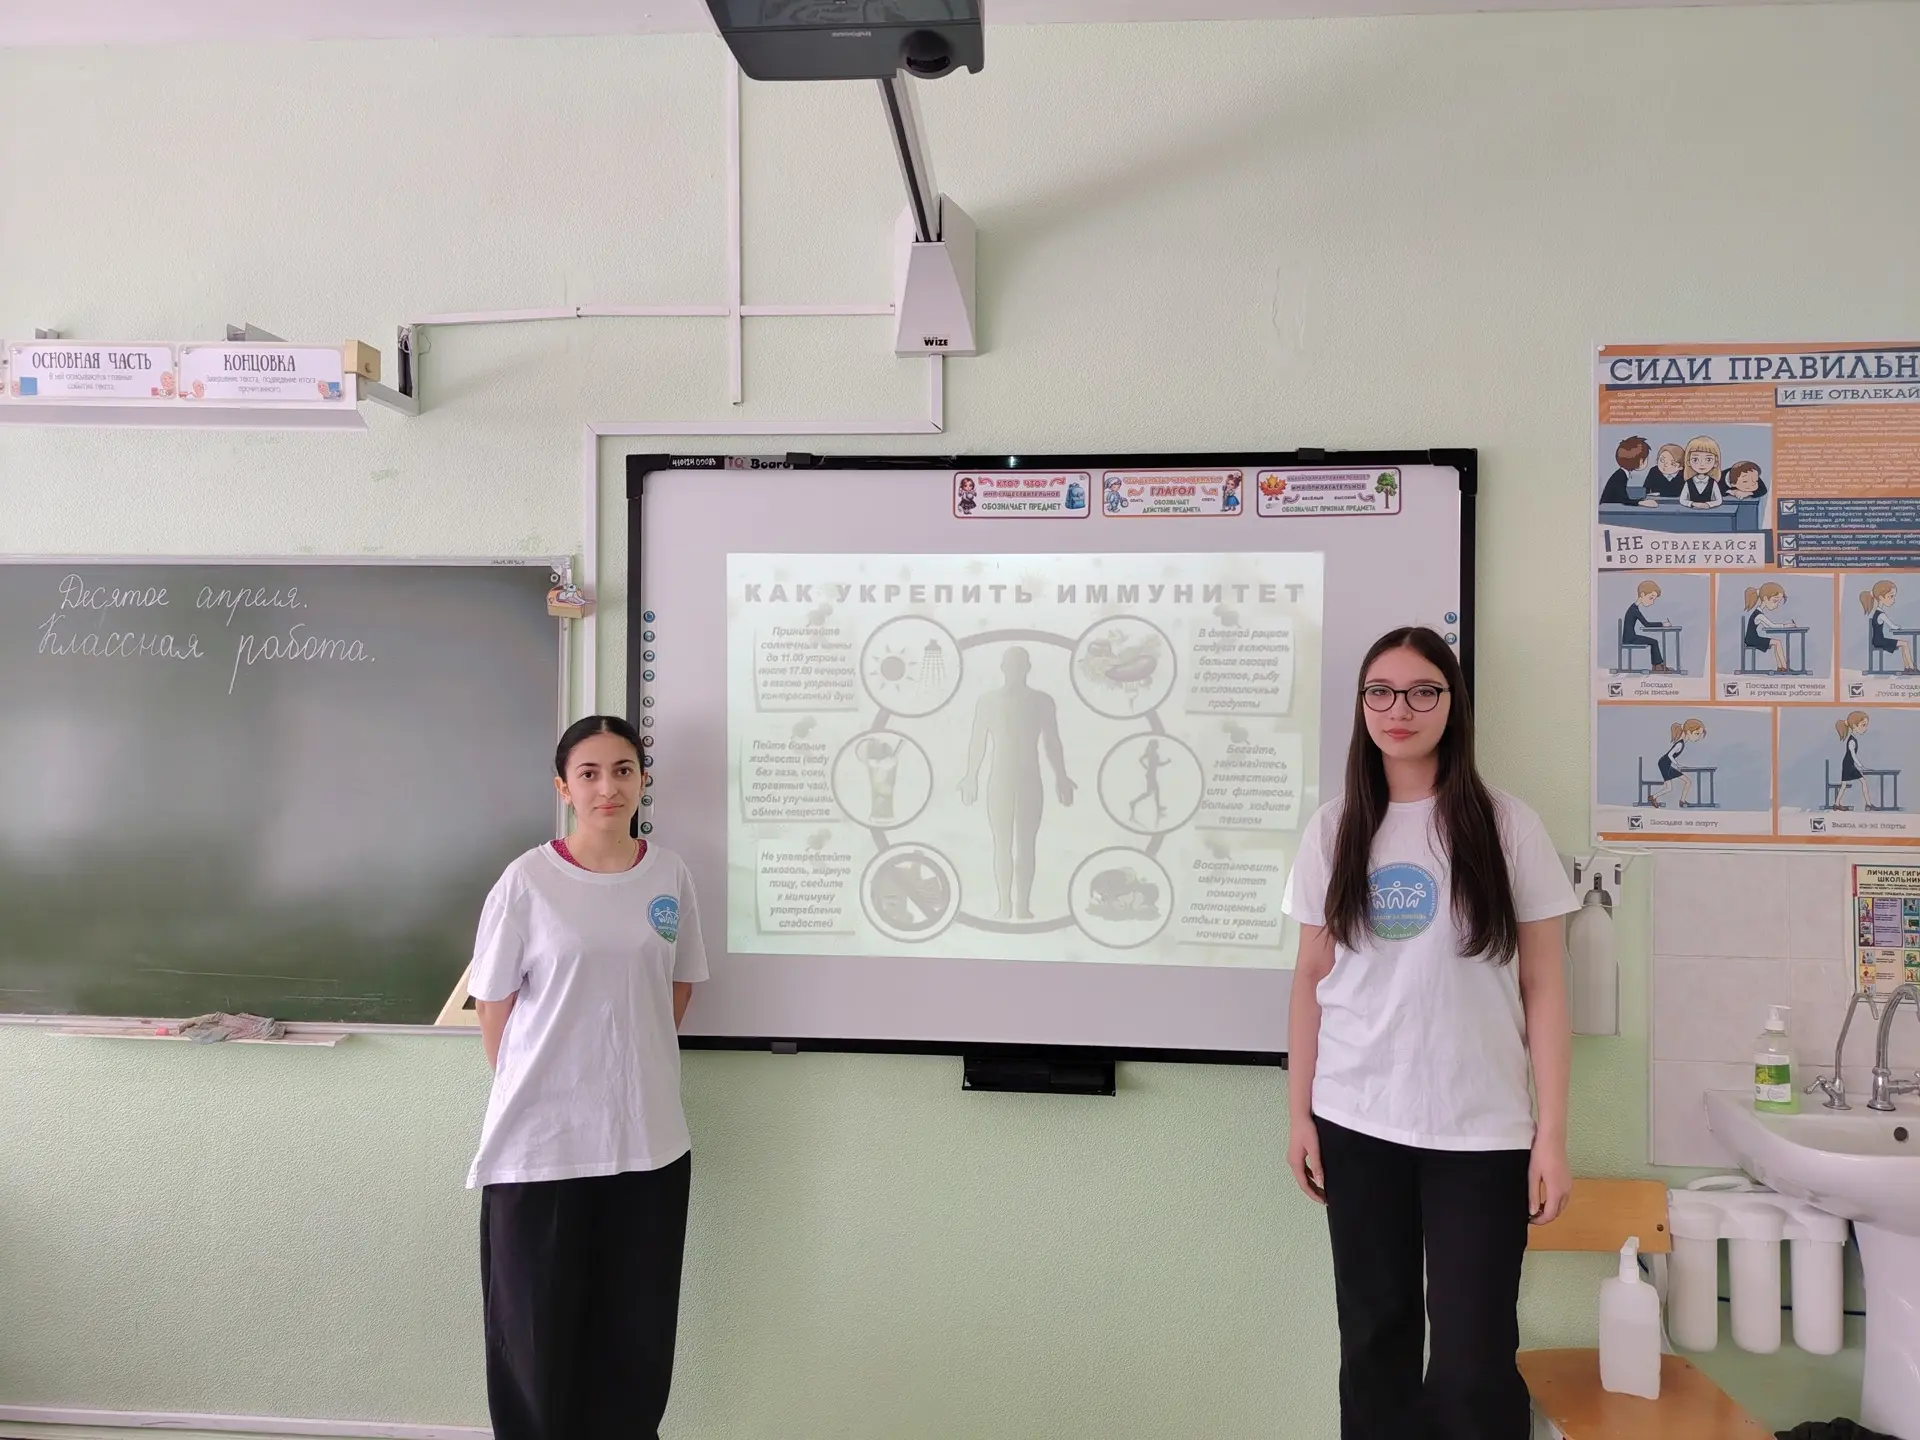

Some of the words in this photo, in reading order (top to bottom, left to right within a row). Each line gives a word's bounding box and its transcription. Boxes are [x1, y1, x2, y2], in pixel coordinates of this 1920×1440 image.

[32, 352, 100, 369] ОСНОВНАЯ
[108, 353, 152, 370] ЧАСТЬ
[224, 354, 296, 372] КОНЦОВКА
[1610, 358, 1712, 384] СИДИ
[1728, 355, 1918, 380] ПРАВИЛЬН
[1784, 390, 1796, 400] И
[1802, 390, 1824, 400] НЕ
[1829, 387, 1920, 400] ОТВЛЕКАЙ
[1150, 486, 1196, 496] ГЛАГОЛ
[982, 502, 1027, 510] ОБОЗНАЧАЕТ
[1028, 503, 1062, 511] ПРЕДМЕТ
[1616, 536, 1644, 551] НЕ
[1650, 538, 1757, 550] ОТВЛЕКАЙСЯ
[1620, 554, 1638, 564] ВО
[1646, 554, 1697, 564] ВРЕМЯ
[1704, 554, 1757, 564] УРОКА
[745, 584, 813, 603] КАК
[836, 584, 1033, 603] УКРЕПИТЬ
[1057, 584, 1304, 604] ИММУНИТЕТ
[58, 573, 170, 610] Десятое
[196, 584, 308, 626] апреля.
[772, 626, 840, 638] Принимайте
[38, 612, 204, 659] Классная
[228, 623, 376, 695] работа.
[1746, 682, 1778, 690] Посадка
[1208, 698, 1260, 710] продукты
[753, 740, 786, 750] Пейте
[788, 740, 826, 751] больше
[1226, 744, 1276, 756] Бегайте,
[749, 754, 800, 764] жидкости
[1212, 774, 1288, 784] гимнастикой
[1206, 788, 1228, 796] или
[746, 794, 780, 803] чтобы
[752, 808, 782, 816] обмен
[1249, 802, 1291, 812] ходите
[1650, 819, 1683, 828] Посадка
[1696, 820, 1718, 828] парту
[1832, 822, 1856, 830] Выход
[1193, 859, 1279, 872] Восстановить
[800, 878, 844, 888] сведите
[1198, 876, 1267, 886] иммунитет
[784, 894, 836, 904] минимуму
[1206, 890, 1257, 901] помогут
[1190, 902, 1266, 914] полноценный
[778, 918, 834, 928] сладостей
[1181, 914, 1220, 925] отдых
[1196, 930, 1236, 940] ночной
[1238, 932, 1259, 940] сон
